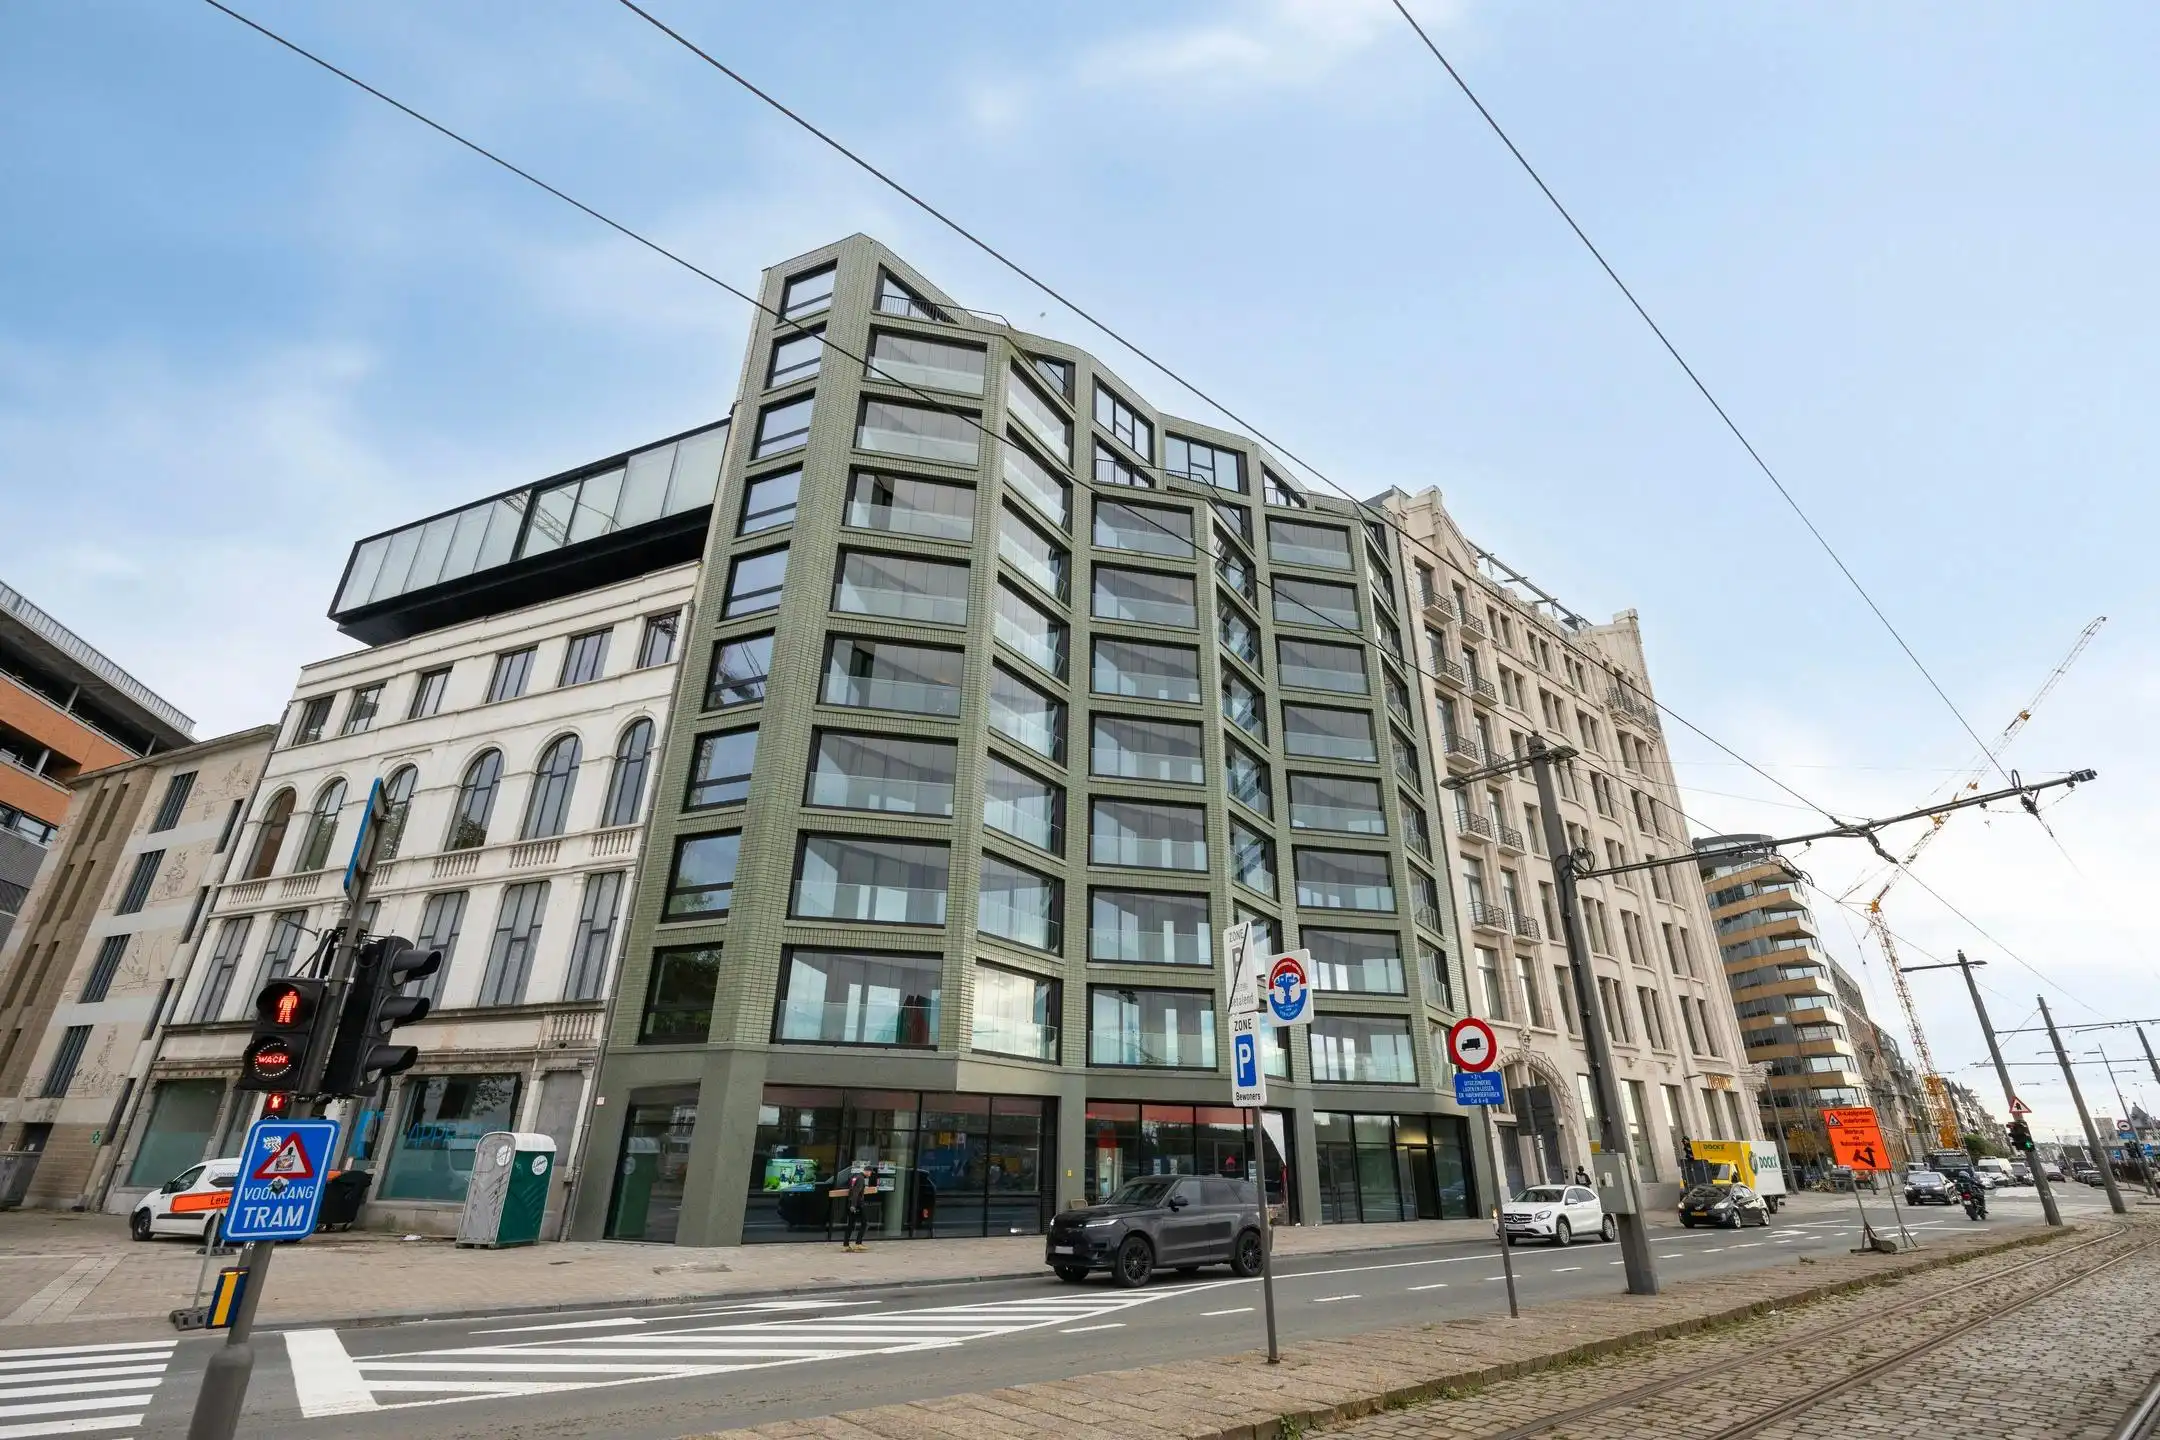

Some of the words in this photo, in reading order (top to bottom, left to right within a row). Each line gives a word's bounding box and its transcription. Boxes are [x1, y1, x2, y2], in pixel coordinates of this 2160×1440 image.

[1229, 928, 1245, 942] ZONE
[1234, 1018, 1252, 1032] ZONE
[1238, 1043, 1252, 1079] P
[1236, 1092, 1260, 1102] Bewoners
[243, 1205, 304, 1229] TRAM
